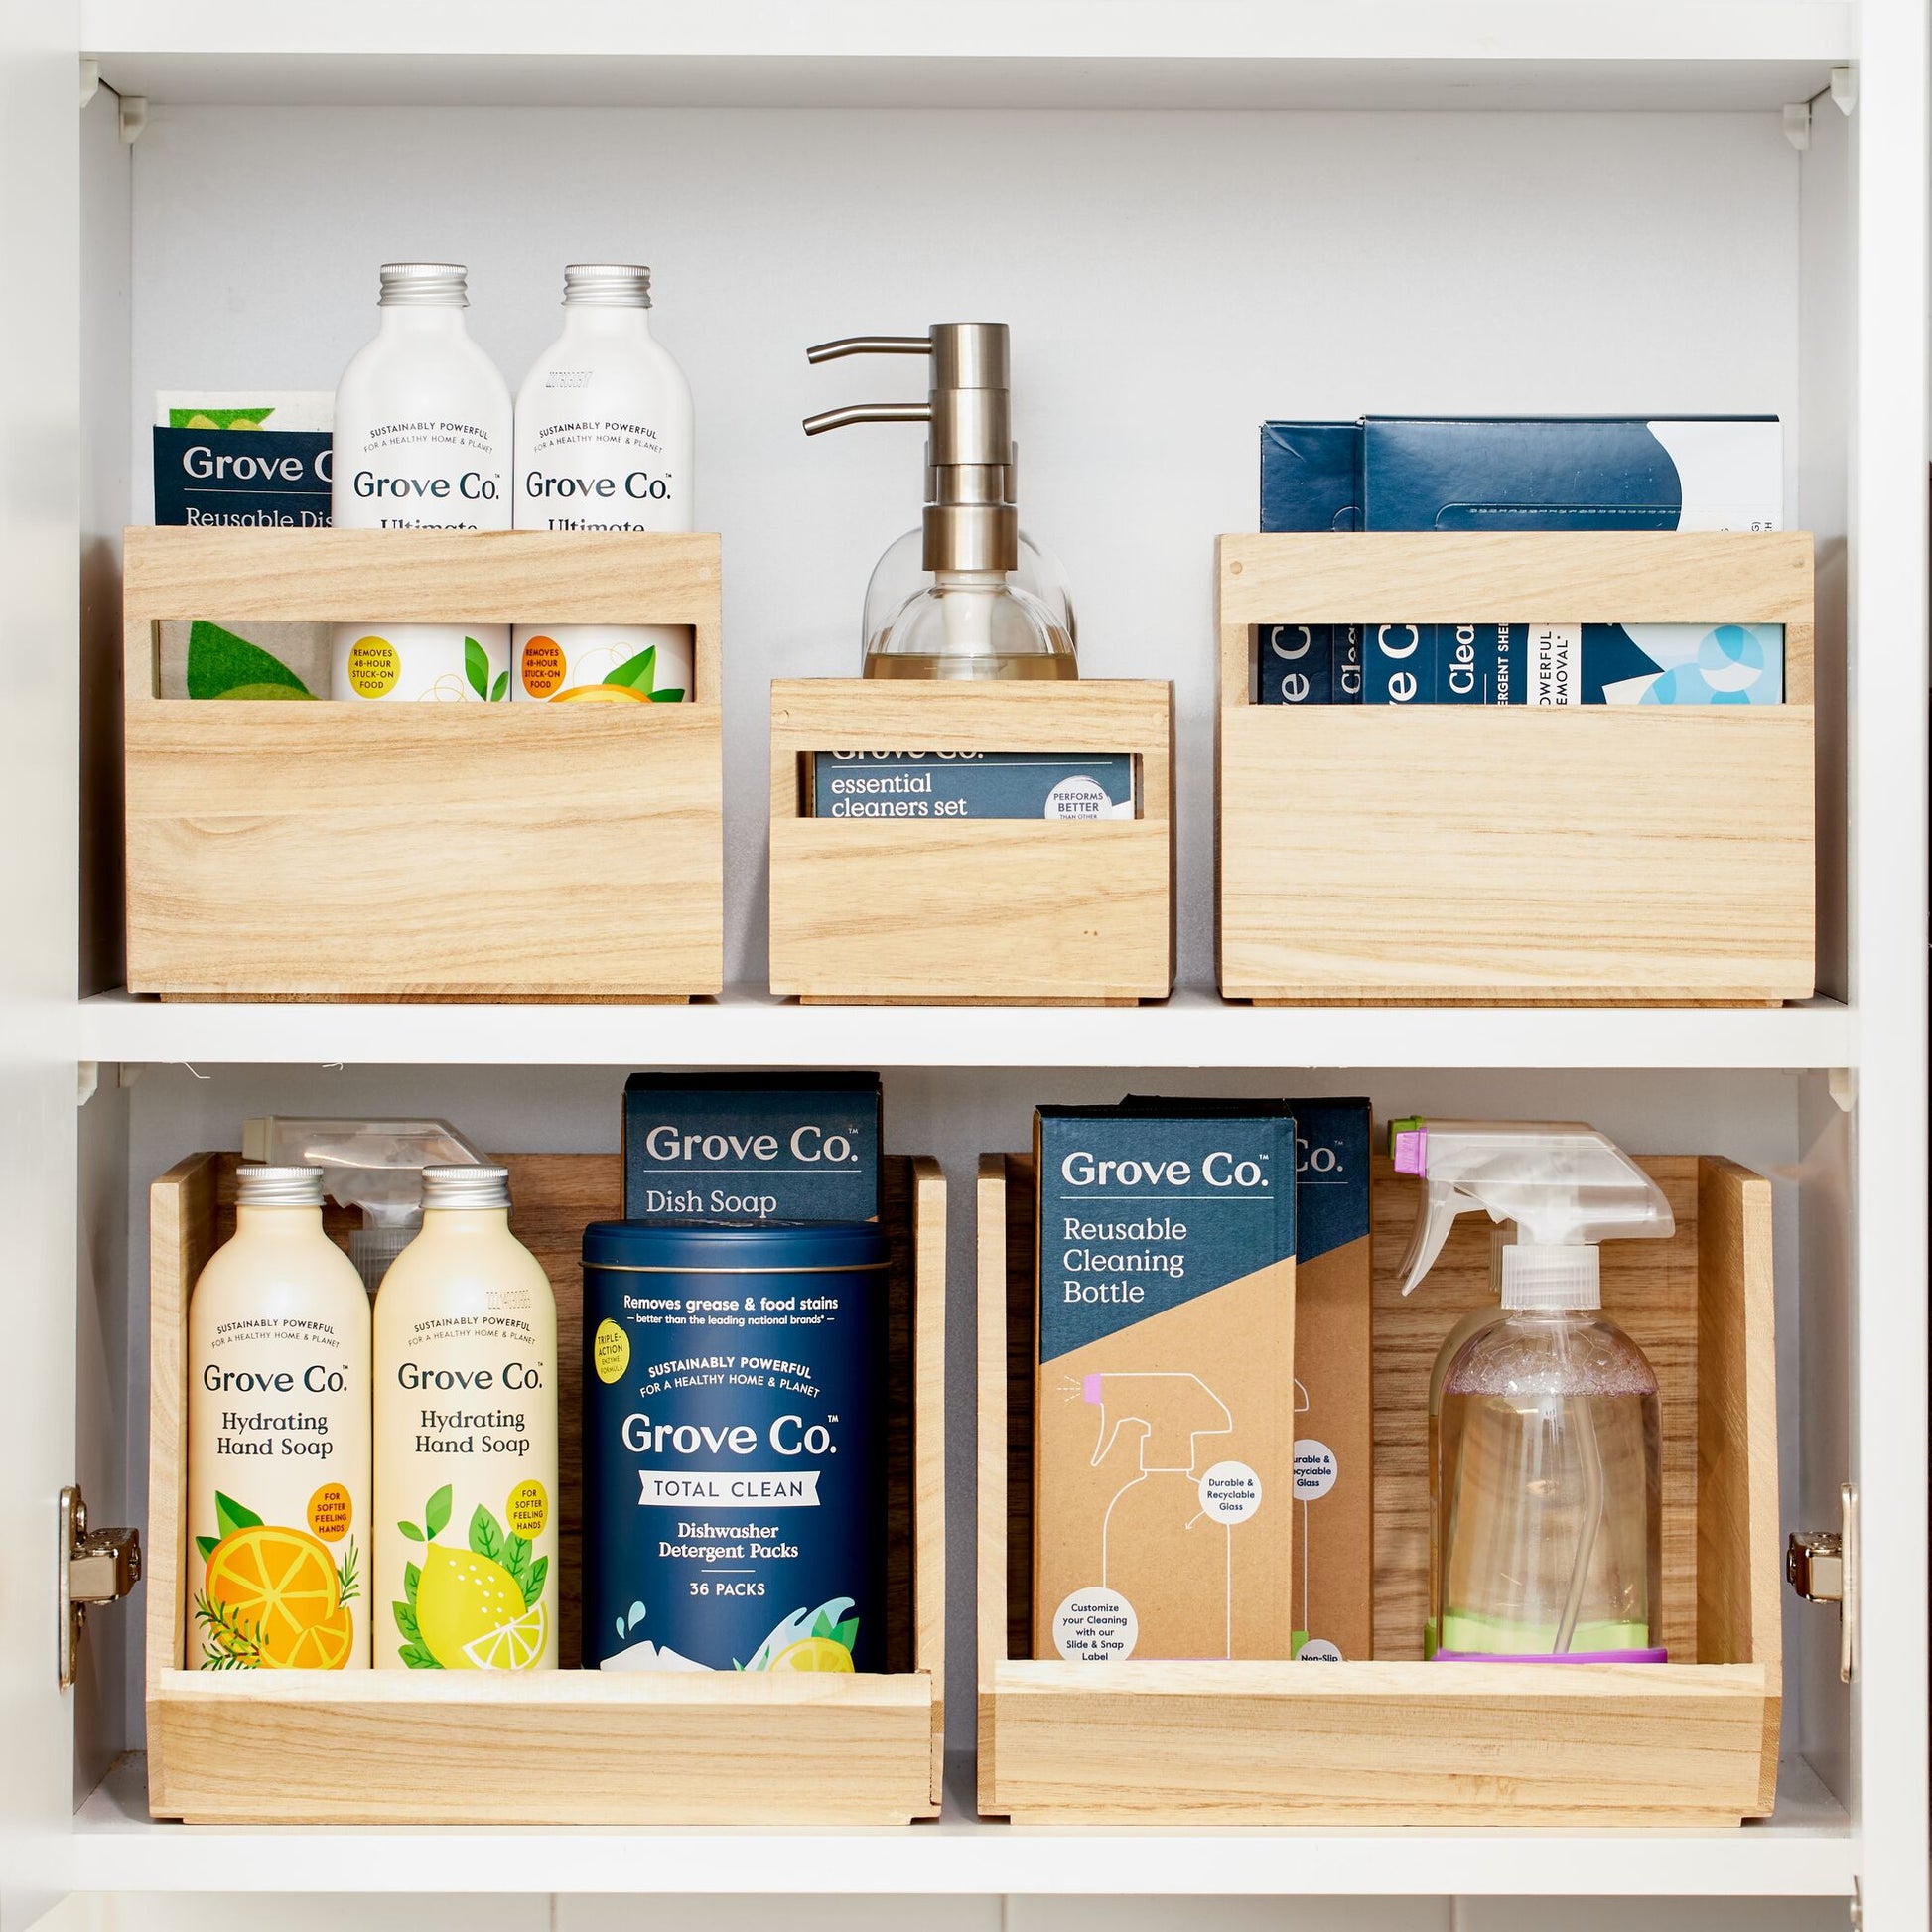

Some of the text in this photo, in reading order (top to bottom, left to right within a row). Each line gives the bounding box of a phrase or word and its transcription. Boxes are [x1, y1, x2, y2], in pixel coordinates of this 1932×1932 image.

[370, 422, 490, 440] SUSTAINABLY POWERFUL
[540, 422, 657, 439] SUSTAINABLY POWERFUL
[363, 442, 379, 453] FOR
[390, 436, 427, 445] HEALTHY
[432, 435, 457, 444] HOME
[469, 439, 492, 454] PLANET
[534, 442, 548, 453] FOR
[557, 435, 592, 445] HEALTHY
[596, 435, 621, 444] HOME
[634, 439, 663, 454] PLANET
[183, 447, 304, 481] Grove
[354, 471, 450, 497] Grove
[526, 471, 616, 497] Grove
[185, 507, 294, 528] Reusable
[832, 772, 932, 794] essential
[832, 797, 968, 817] cleaners set
[1058, 803, 1099, 812] BETTER
[646, 1125, 778, 1161] Grove
[1061, 1151, 1191, 1185] Grove
[646, 1190, 776, 1218] Dish Soap
[1064, 1217, 1187, 1241] Reusable
[1063, 1249, 1184, 1278] Cleaning
[1064, 1281, 1144, 1303] Bottle
[624, 1295, 838, 1313] Removes grease & food stains
[217, 1319, 334, 1334] SUSTAINABLY POWERFUL
[414, 1316, 530, 1332] SUSTAINABLY POWERFUL
[636, 1314, 663, 1324] better
[664, 1314, 686, 1324] than
[688, 1314, 706, 1324] the
[708, 1315, 745, 1326] leading
[748, 1314, 788, 1324] national
[211, 1338, 226, 1348] FOR
[312, 1335, 340, 1348] PLANET
[408, 1336, 423, 1346] FOR
[434, 1330, 471, 1339] HEALTHY
[510, 1332, 536, 1346] PLANET
[598, 1333, 621, 1344] TRIPLE-
[598, 1344, 623, 1356] ACTION
[398, 1362, 493, 1390] Grove
[648, 1356, 812, 1380] SUSTAINABLY POWERFUL
[204, 1364, 294, 1392] Grove
[640, 1374, 820, 1398] FOR A HEALTHY HOME & PLANET
[222, 1412, 328, 1435] Hydrating
[421, 1410, 525, 1432] Hydrating
[621, 1413, 757, 1454] Grove
[217, 1438, 334, 1459] Hand Soap
[415, 1436, 530, 1456] Hand Soap
[653, 1481, 803, 1497] TOTAL CLEAN
[1209, 1478, 1244, 1487] Durable
[515, 1499, 542, 1509] SOFTER
[315, 1513, 347, 1523] FEELING
[514, 1510, 544, 1519] FEELING
[677, 1523, 778, 1539] Dishwasher
[659, 1541, 798, 1563] Detergent Packs
[690, 1583, 765, 1596] 36 PACKS
[1087, 1616, 1128, 1626] Cleaning
[1100, 1640, 1124, 1650] Snap
